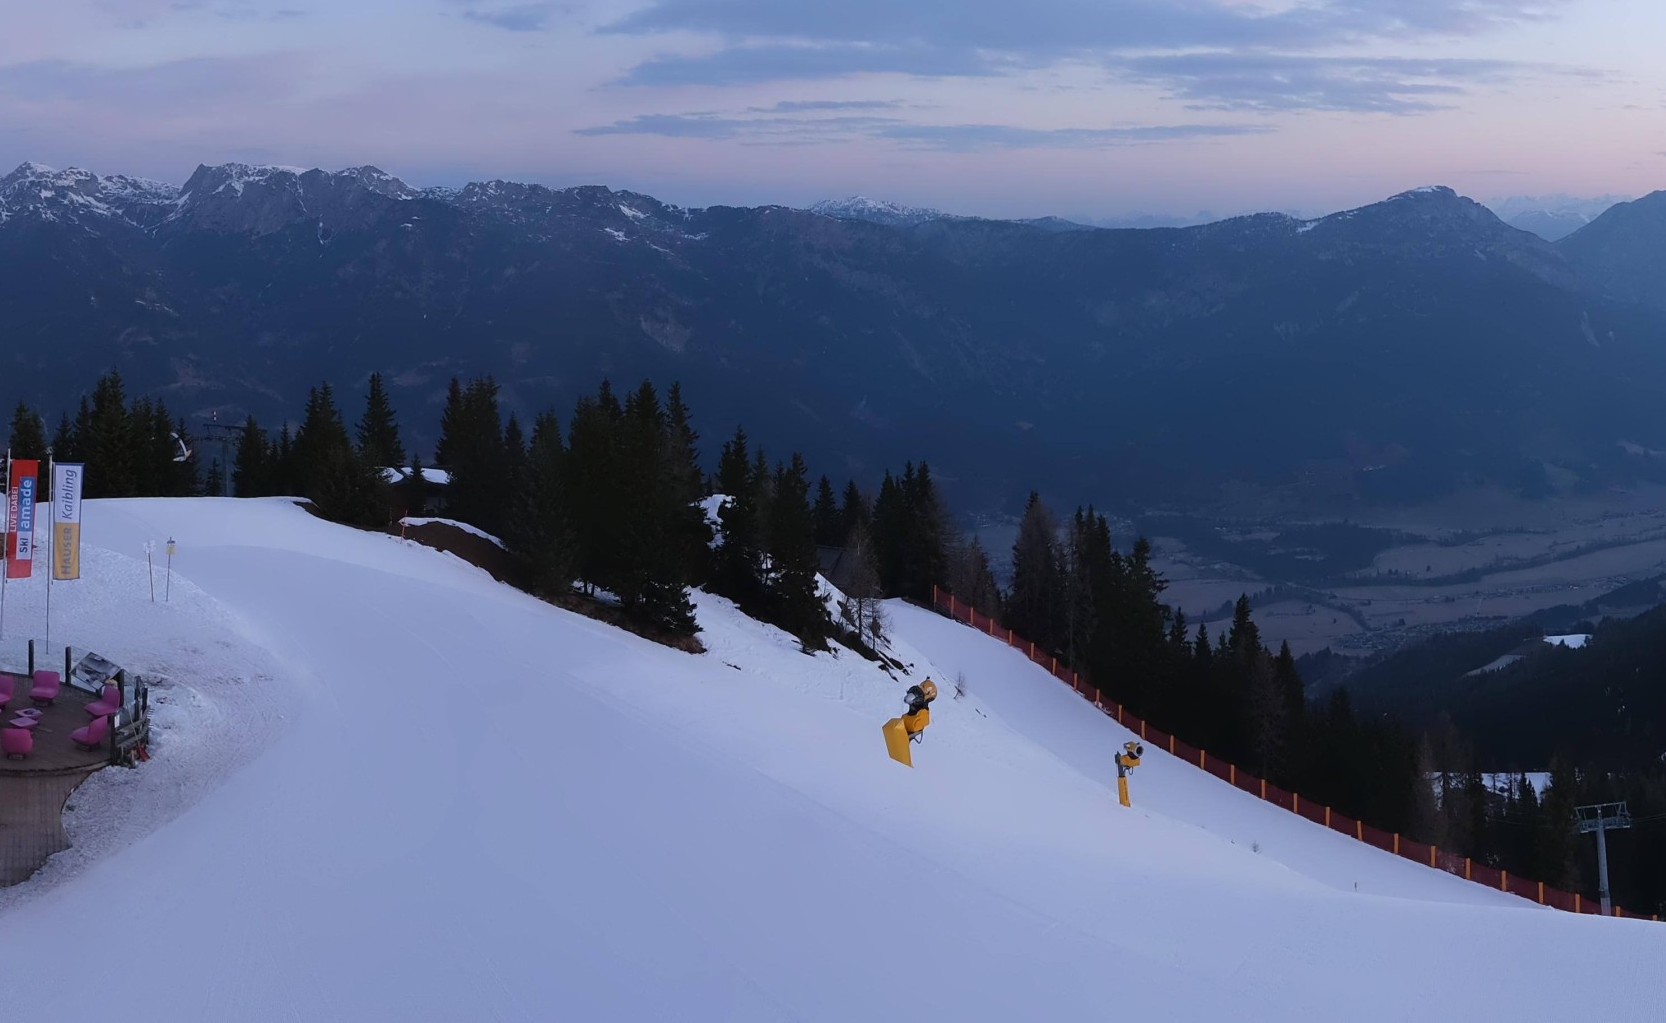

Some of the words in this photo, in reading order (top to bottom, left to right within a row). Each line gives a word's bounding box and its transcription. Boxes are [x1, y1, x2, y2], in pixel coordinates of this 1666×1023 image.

[61, 469, 77, 520] Kaibling
[19, 537, 29, 553] Ski
[61, 527, 72, 575] HAUSER
